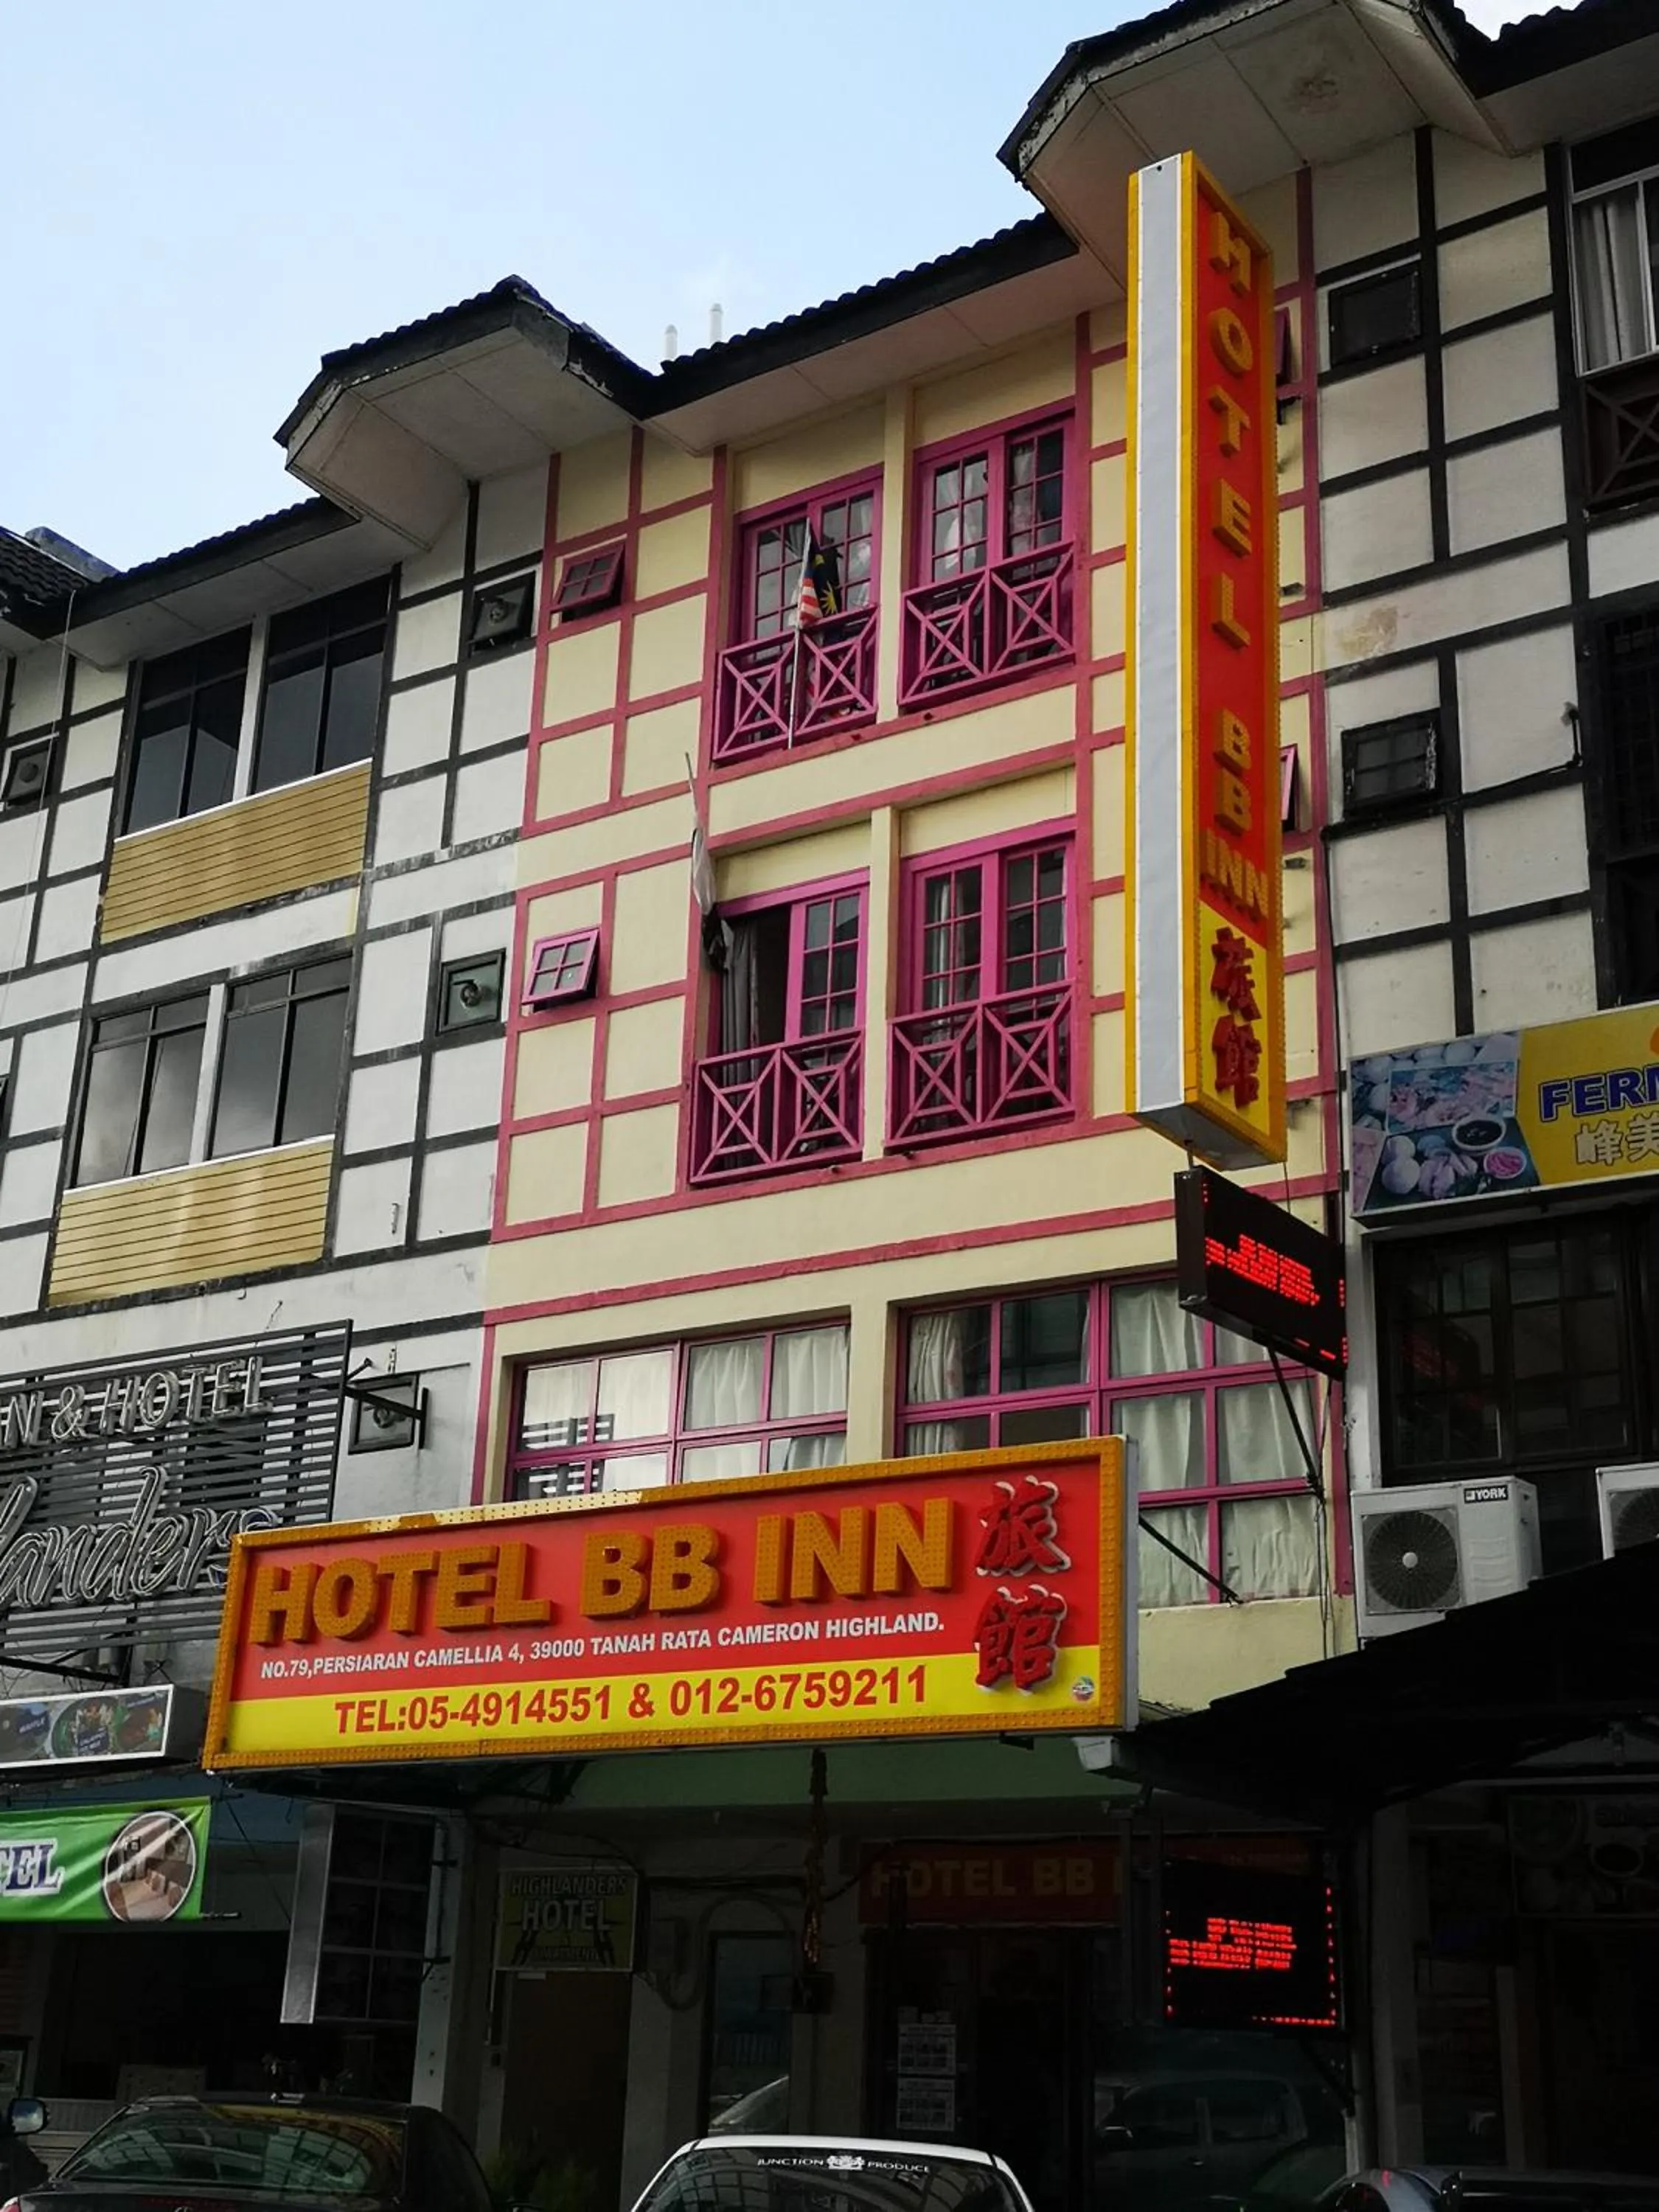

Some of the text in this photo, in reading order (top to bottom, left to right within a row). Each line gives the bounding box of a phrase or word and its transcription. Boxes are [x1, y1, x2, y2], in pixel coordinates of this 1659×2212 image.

[1202, 211, 1268, 922] HOTEL BB INN
[52, 1385, 94, 1439] &
[99, 1355, 273, 1435] HOTEL
[1475, 1487, 1506, 1500] YORK
[249, 1498, 955, 1645] HOTEL BB INN
[260, 1613, 945, 1680] NO.79,PERSIARAN CAMELLIA 4, 39000 TANAH RATA CAMERON HIGHLAND.
[335, 1665, 927, 1734] TEL:05-4914551 & 012-6759211
[0, 1839, 64, 1896] EL
[512, 1874, 626, 1896] HIGHLANDERS
[1033, 1857, 1094, 1897] BB
[521, 1899, 611, 1931] HOTEL
[757, 2158, 930, 2173] JUNCTION PRODUCE
